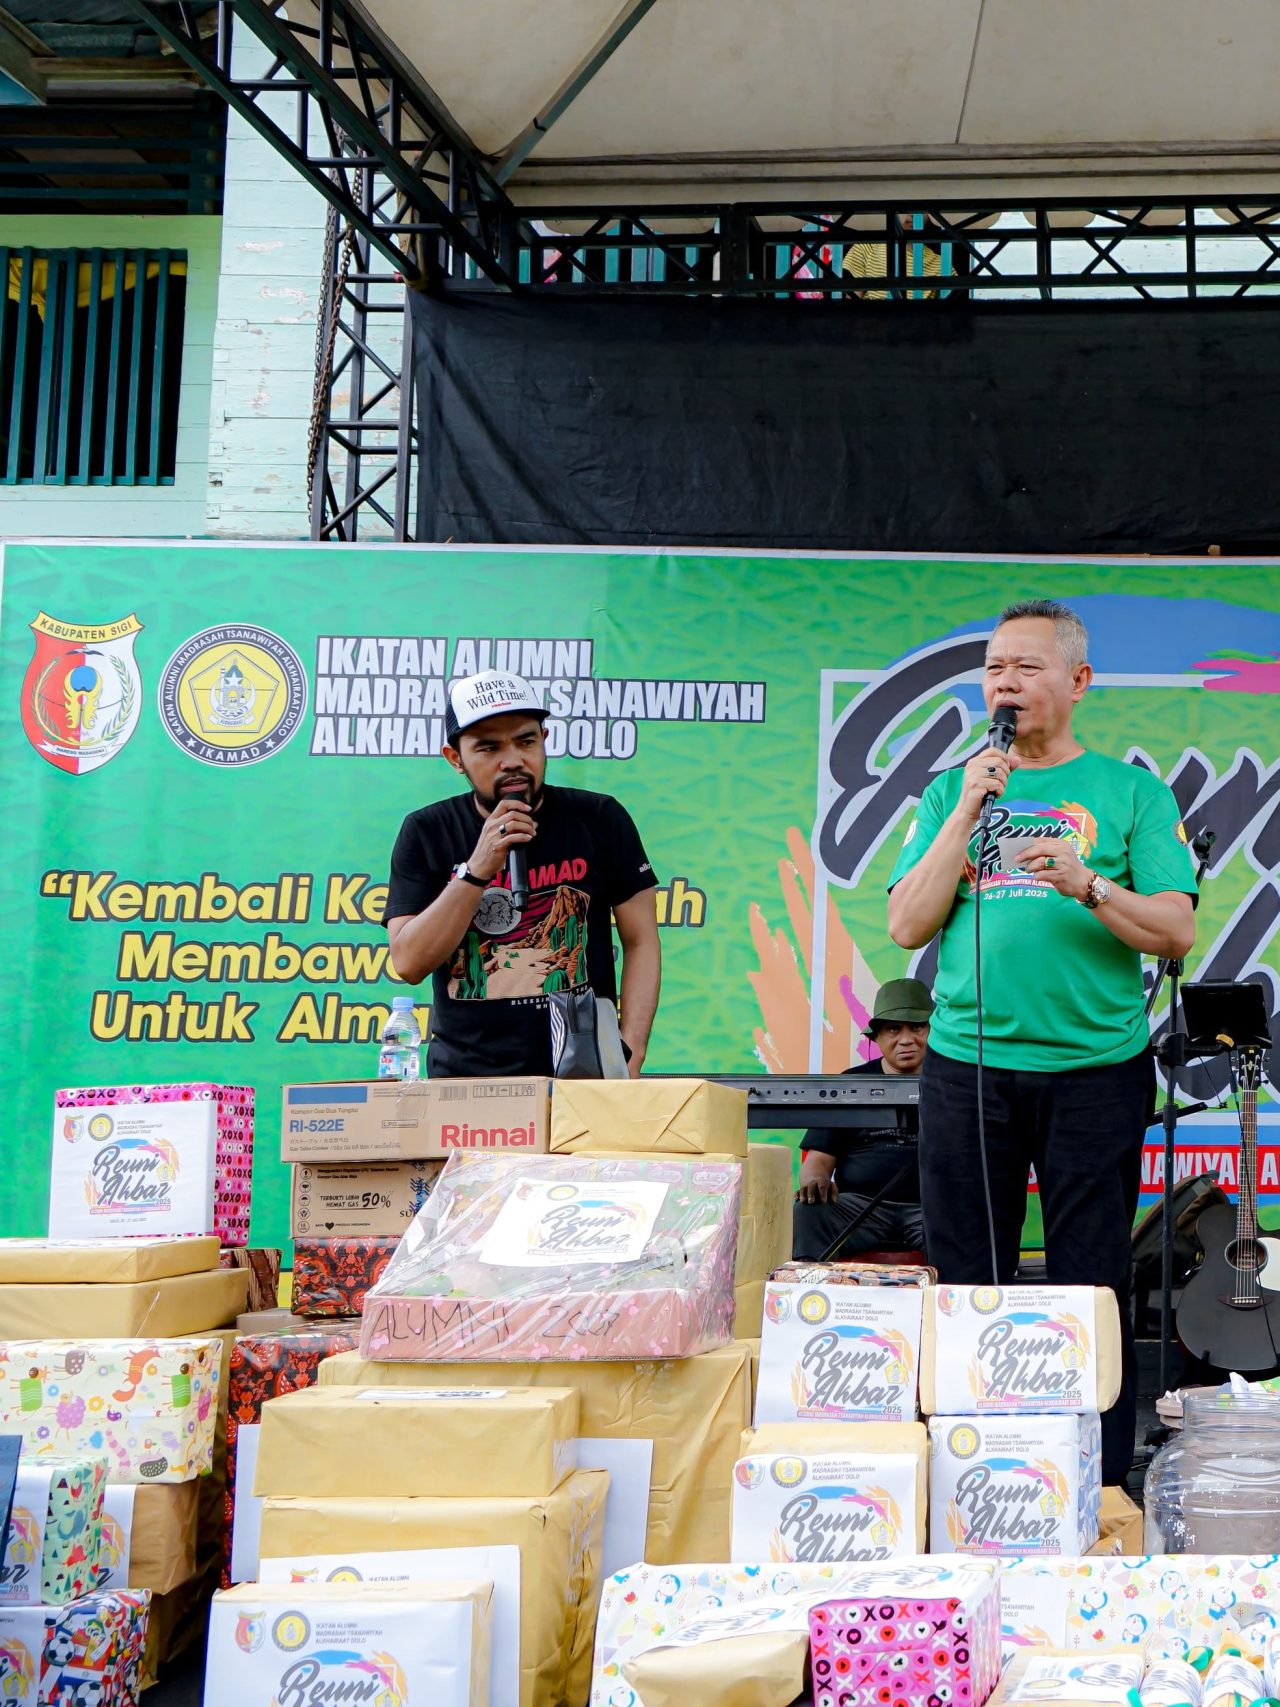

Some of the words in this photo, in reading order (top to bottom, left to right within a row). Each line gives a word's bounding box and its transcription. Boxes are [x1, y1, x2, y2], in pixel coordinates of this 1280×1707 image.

[40, 618, 105, 639] KABUPATEN
[111, 621, 132, 635] SIGI
[227, 631, 287, 656] TSANAWIYAH
[177, 631, 225, 666] MADRASAH
[318, 637, 447, 676] IKATAN
[453, 639, 593, 677] ALUMNI
[165, 665, 180, 701] ALUMNI
[282, 655, 302, 711] ALKHAIRAAT
[315, 678, 456, 716] MADRA
[467, 691, 495, 711] Wild
[496, 690, 528, 705] Time!
[474, 678, 506, 694] Have
[508, 679, 516, 689] a
[165, 702, 185, 736] IKATAN
[278, 711, 298, 737] DOLO
[199, 746, 260, 762] IKAMAD
[309, 717, 447, 757] ALKHAI
[544, 719, 637, 759] DOLO
[983, 891, 1005, 900] 26-27
[1008, 888, 1023, 898] Juli
[1025, 889, 1048, 898] 2025
[91, 992, 256, 1042] Untuk
[289, 1119, 345, 1132] RI-522E
[441, 1122, 536, 1148] Rinnai
[92, 1145, 160, 1181] Reuni
[97, 1174, 171, 1206] Akbar
[802, 1331, 890, 1377] Reuni
[977, 1320, 1065, 1368] Reuni
[806, 1368, 903, 1409] Akbar
[985, 1356, 1082, 1398] Akbar
[1062, 1390, 1082, 1399] 2025
[882, 1405, 902, 1414] 2025
[955, 1465, 1043, 1512] Reuni
[780, 1494, 874, 1543] Reuni
[964, 1503, 1061, 1546] Akbar
[1040, 1538, 1061, 1546] 2025
